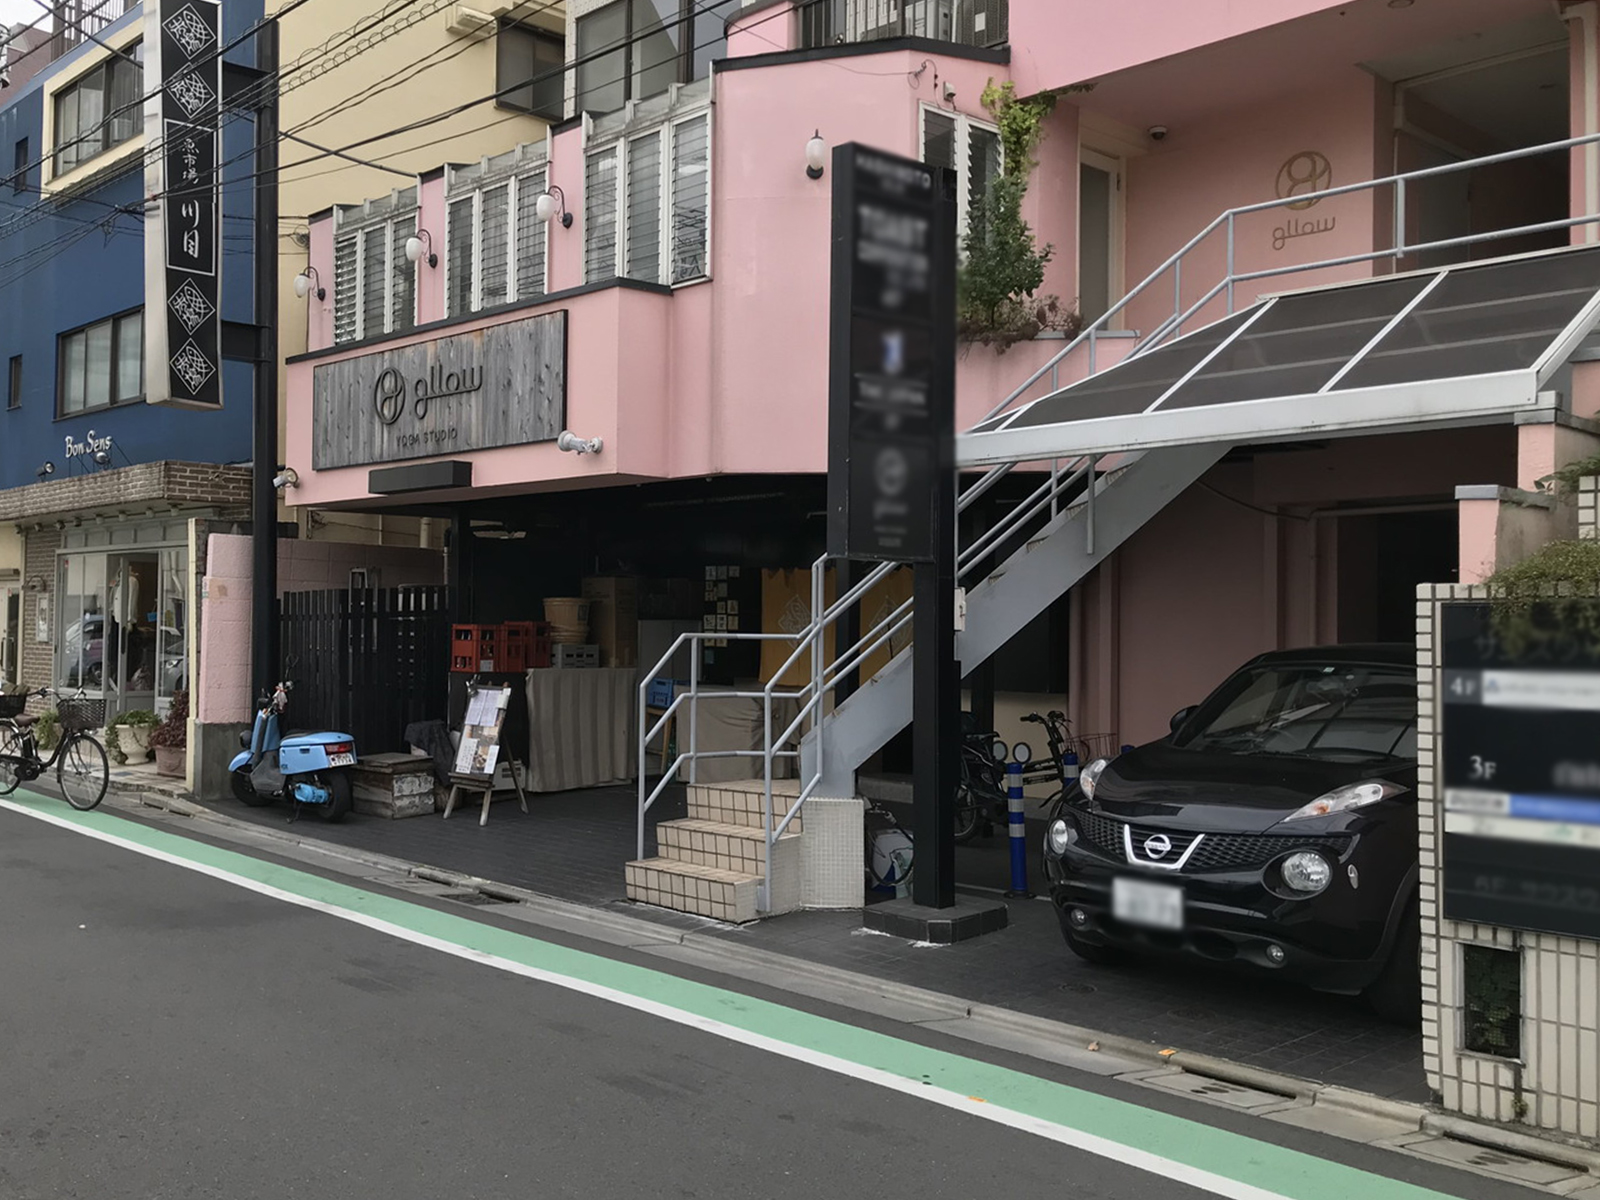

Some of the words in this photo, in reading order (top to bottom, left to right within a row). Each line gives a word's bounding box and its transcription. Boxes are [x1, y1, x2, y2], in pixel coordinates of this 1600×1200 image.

[1272, 216, 1335, 251] gllow
[414, 363, 483, 420] gllow
[65, 435, 85, 458] Bon
[86, 430, 113, 453] Sens
[396, 433, 420, 447] YOGA
[423, 427, 459, 444] STUDIO
[1468, 755, 1497, 780] 3F
